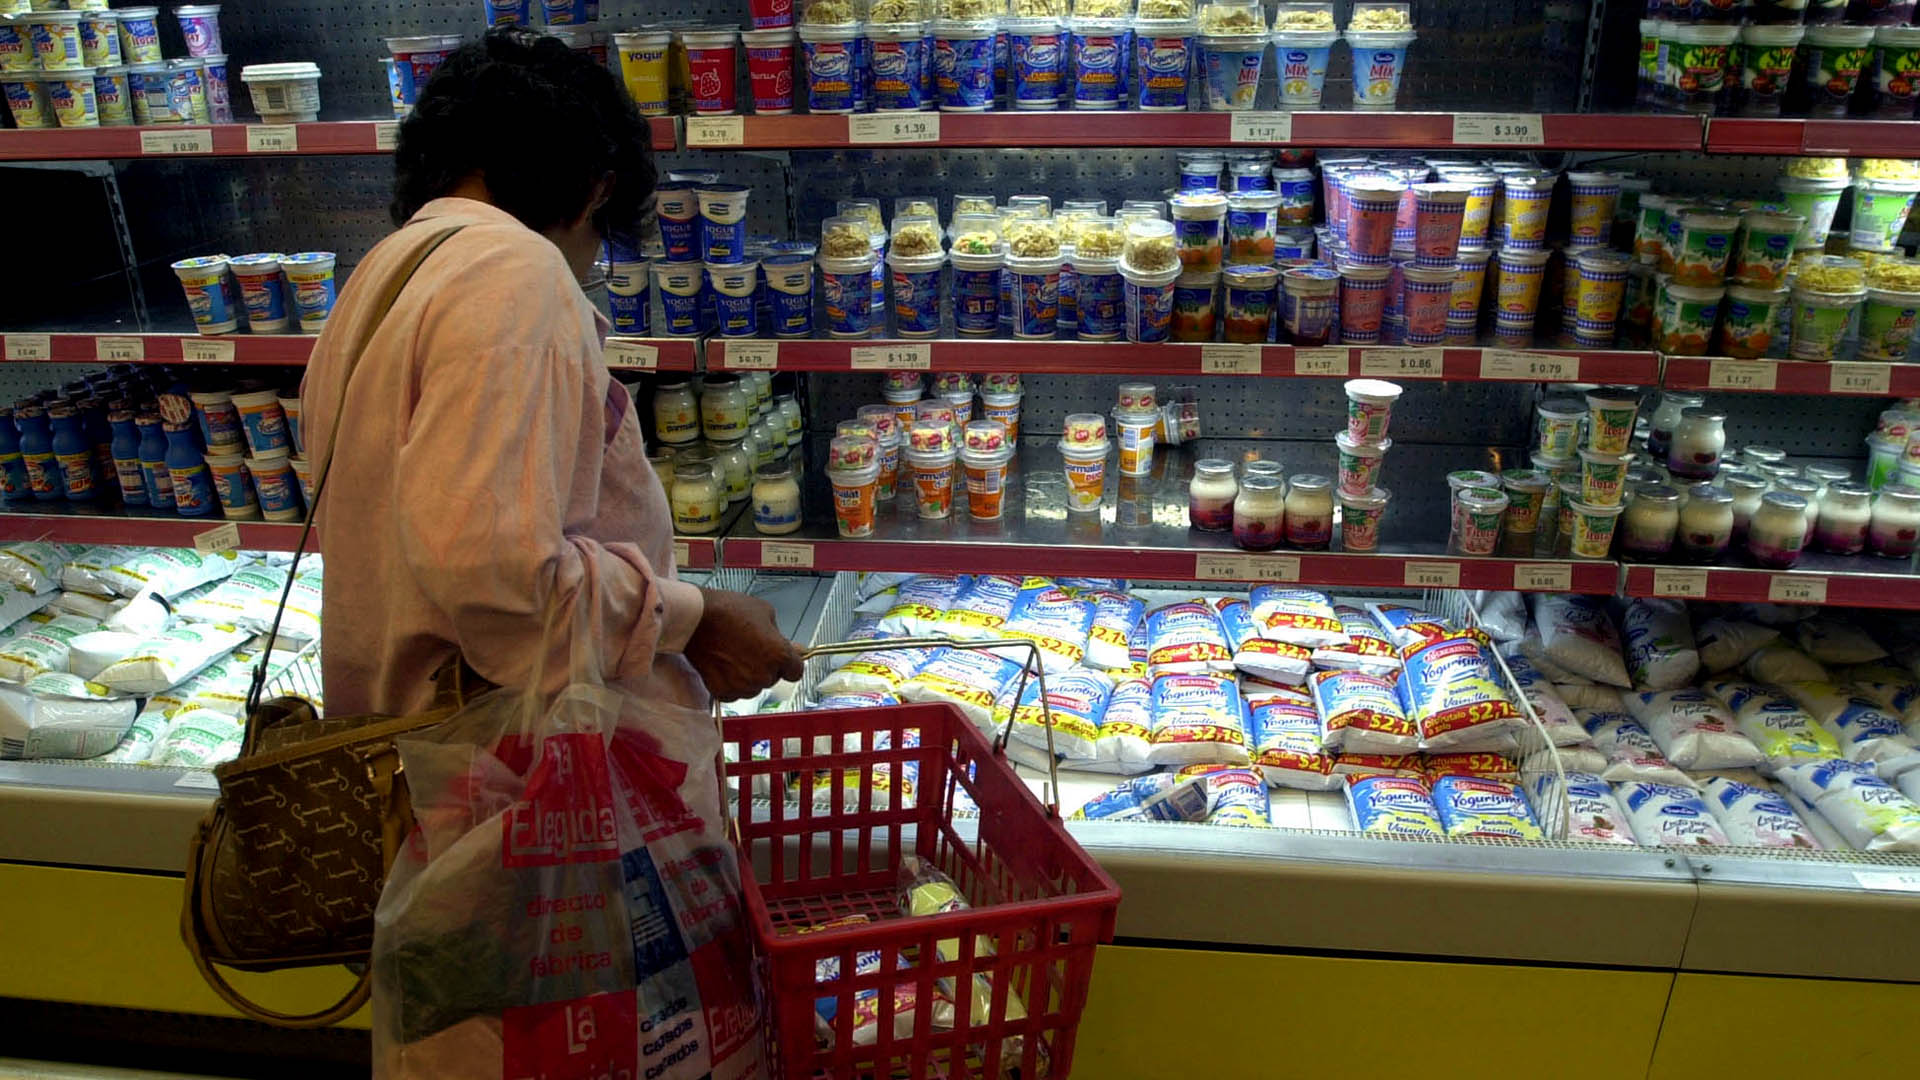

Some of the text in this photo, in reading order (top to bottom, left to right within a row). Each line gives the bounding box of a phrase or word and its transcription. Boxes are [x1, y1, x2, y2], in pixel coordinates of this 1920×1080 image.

[628, 51, 664, 62] yogur
[1285, 64, 1308, 78] Mix
[1371, 65, 1396, 79] Mix
[905, 123, 926, 134] 1.39
[1257, 128, 1275, 137] 1.37
[181, 143, 199, 152] 0.99
[626, 355, 646, 366] 0.79
[897, 353, 917, 363] 1.39
[1408, 358, 1432, 369] 0.86
[1539, 363, 1562, 374] 0.79
[511, 795, 618, 853] Elegida
[526, 891, 607, 918] directo
[550, 923, 583, 944] de
[529, 949, 612, 978] fabrica
[565, 999, 598, 1054] La
